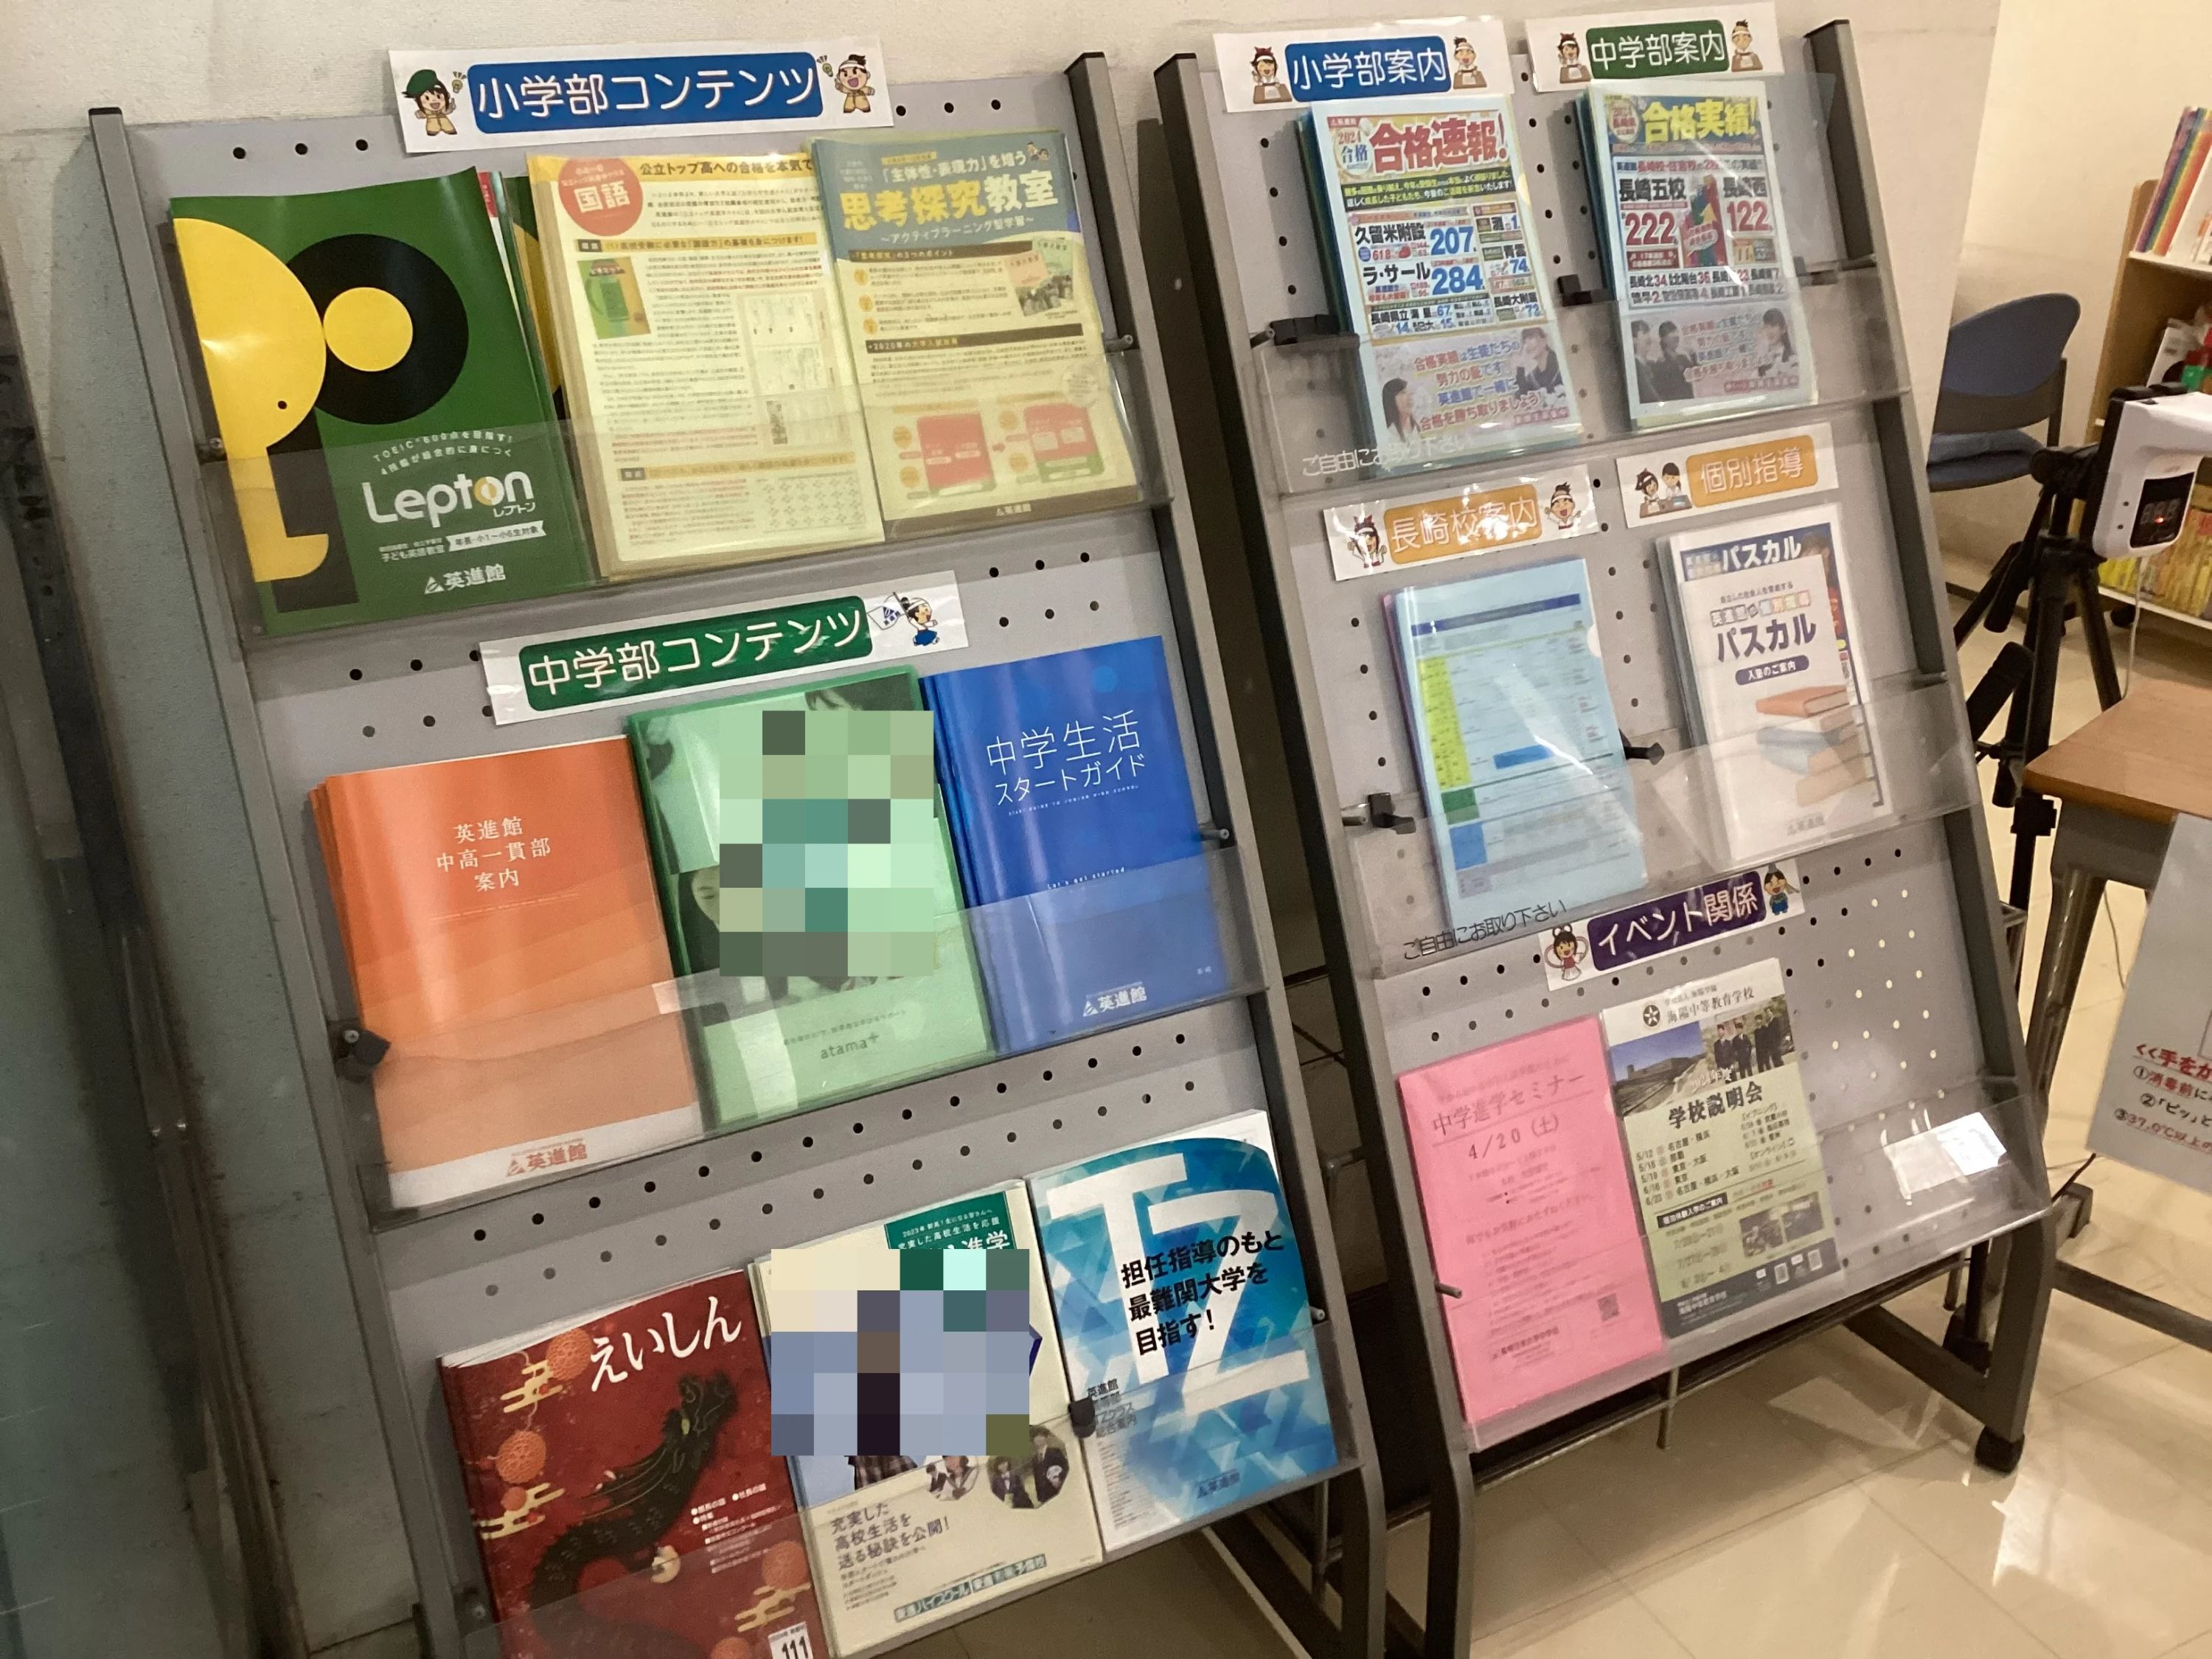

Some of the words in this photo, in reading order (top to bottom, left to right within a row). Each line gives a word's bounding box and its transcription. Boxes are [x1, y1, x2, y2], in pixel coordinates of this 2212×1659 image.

[1292, 49, 1447, 91] 小学部案内
[1591, 30, 1726, 68] 中学部案内
[478, 67, 814, 119] 小学部コンテンツ
[1369, 112, 1508, 173] 合格速報!
[1642, 94, 1758, 144] 合格実績!
[1340, 145, 1368, 164] 合格
[574, 180, 631, 215] 国語
[839, 170, 1060, 232] 思考探究教室
[1354, 223, 1426, 246] 久留米附設
[1430, 225, 1474, 256] 207
[1624, 211, 1676, 246] 222
[1726, 200, 1771, 232] 122
[1363, 261, 1431, 286] ラ・サール
[1431, 264, 1484, 296] 284
[1654, 274, 1668, 287] 34
[1436, 305, 1451, 317] 67
[1700, 447, 1806, 494] 個別指導
[361, 470, 534, 529] Lepton
[1391, 495, 1538, 552] 長崎校案内
[1722, 535, 1802, 571] パスカル
[442, 563, 507, 591] 英進館
[528, 609, 861, 695] 中学部コンテンツ
[1717, 613, 1817, 663] パスカル
[986, 709, 1141, 776] 中学生活
[995, 753, 1145, 806] スタートガイド
[453, 815, 524, 844] 英進館
[437, 837, 552, 873] 中高一貫部
[473, 867, 520, 892] 案内
[1402, 900, 1568, 960] ご自由にお取り下さい
[1598, 881, 1759, 956] イベント関係
[1097, 987, 1147, 1012] 英進館
[1666, 987, 1755, 1023] 海陽中等教育学校
[1433, 1074, 1585, 1136] 中学進学セミナー
[1668, 1081, 1763, 1130] 学校説明会
[526, 1142, 588, 1171] 英進館
[1468, 1127, 1521, 1161] 4/20
[1531, 1113, 1559, 1138] (土)
[1121, 1229, 1284, 1289] 担任指導のもと
[1128, 1262, 1269, 1322] 最難関大学を
[590, 1295, 742, 1393] えいしん
[1135, 1308, 1215, 1356] 目指す!
[831, 1502, 890, 1535] 充実した
[834, 1512, 912, 1552] 高校生活を
[838, 1517, 950, 1571] 送る秘訣を公開!
